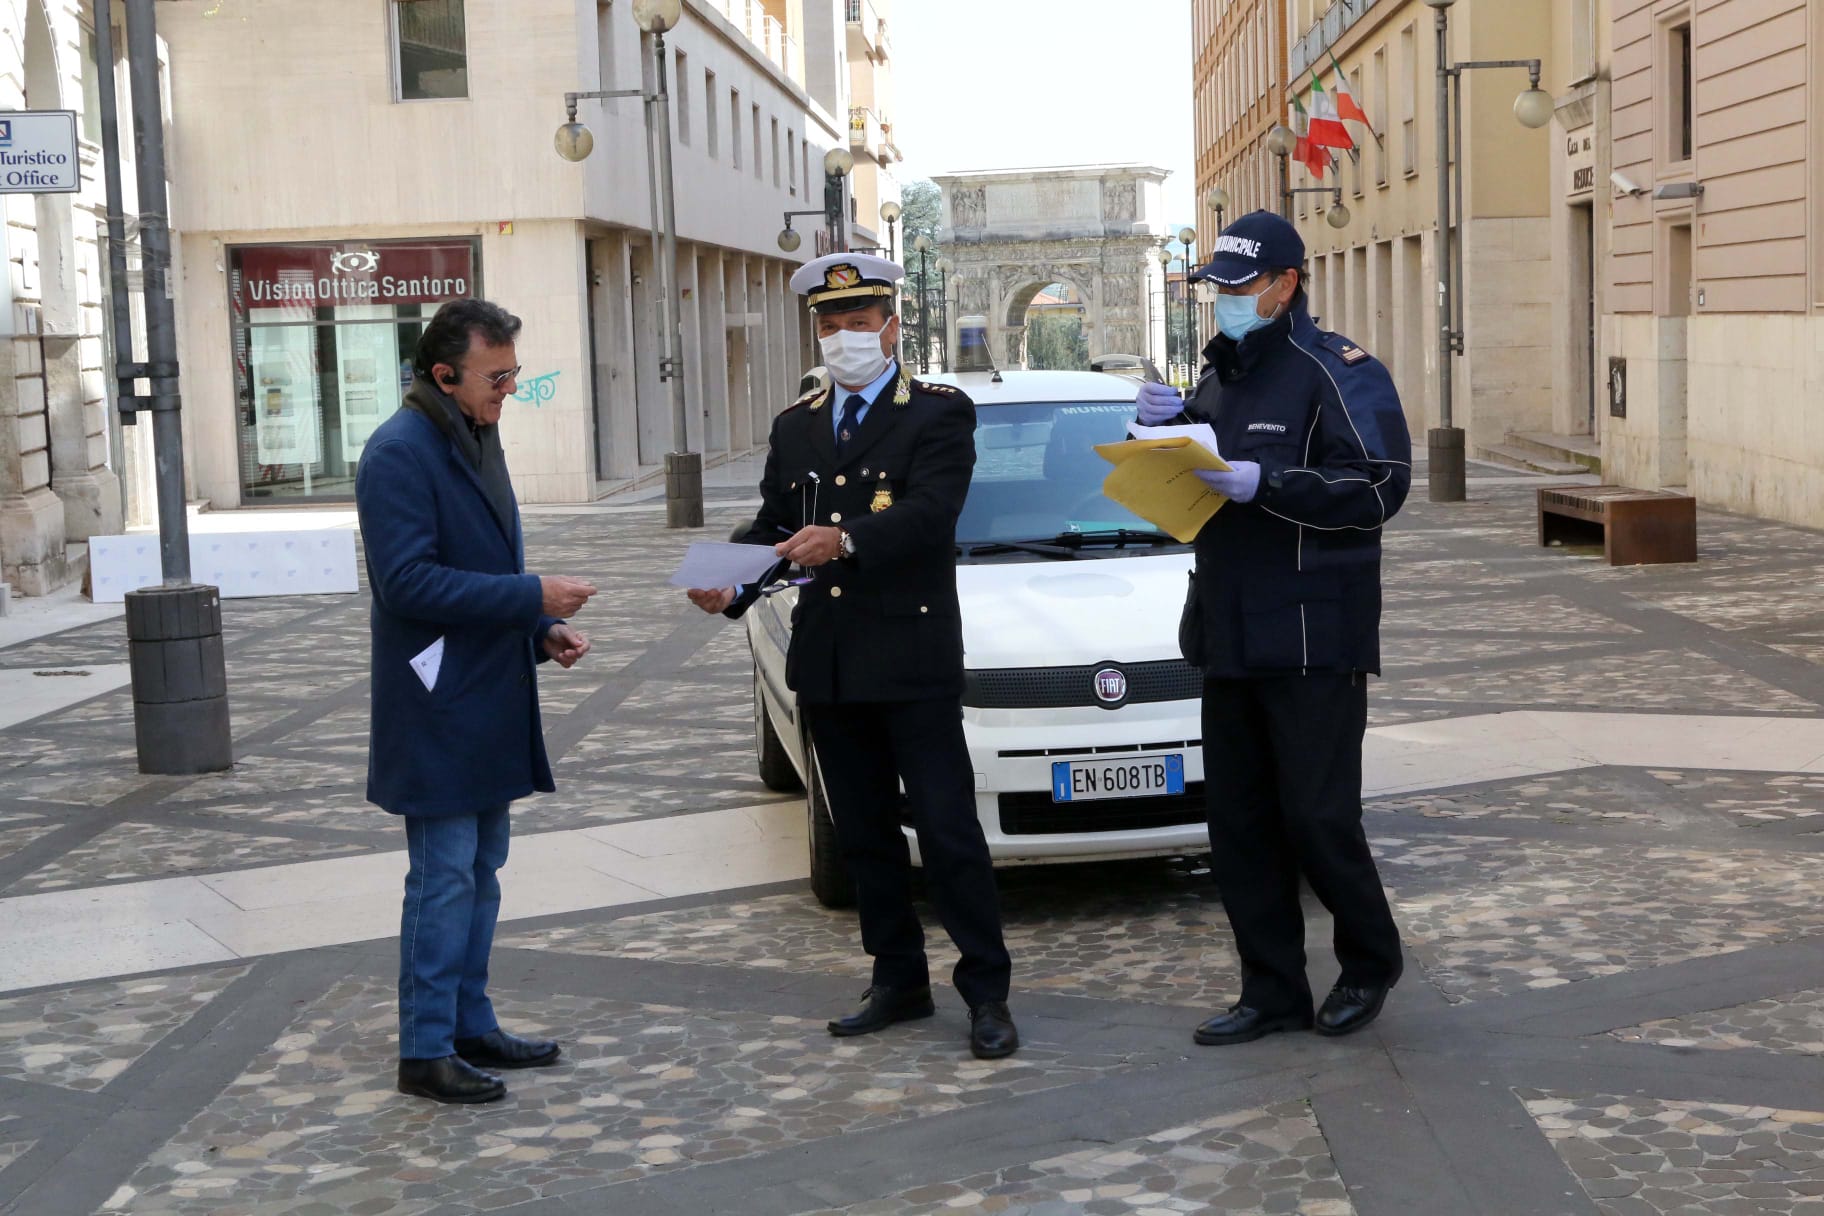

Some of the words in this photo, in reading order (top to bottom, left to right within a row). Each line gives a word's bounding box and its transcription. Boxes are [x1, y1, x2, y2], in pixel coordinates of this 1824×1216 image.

[0, 149, 67, 165] Turistico
[6, 170, 59, 186] Office
[382, 275, 466, 297] Santoro
[1247, 423, 1286, 432] BENEVENTO
[1101, 678, 1120, 694] FIAT
